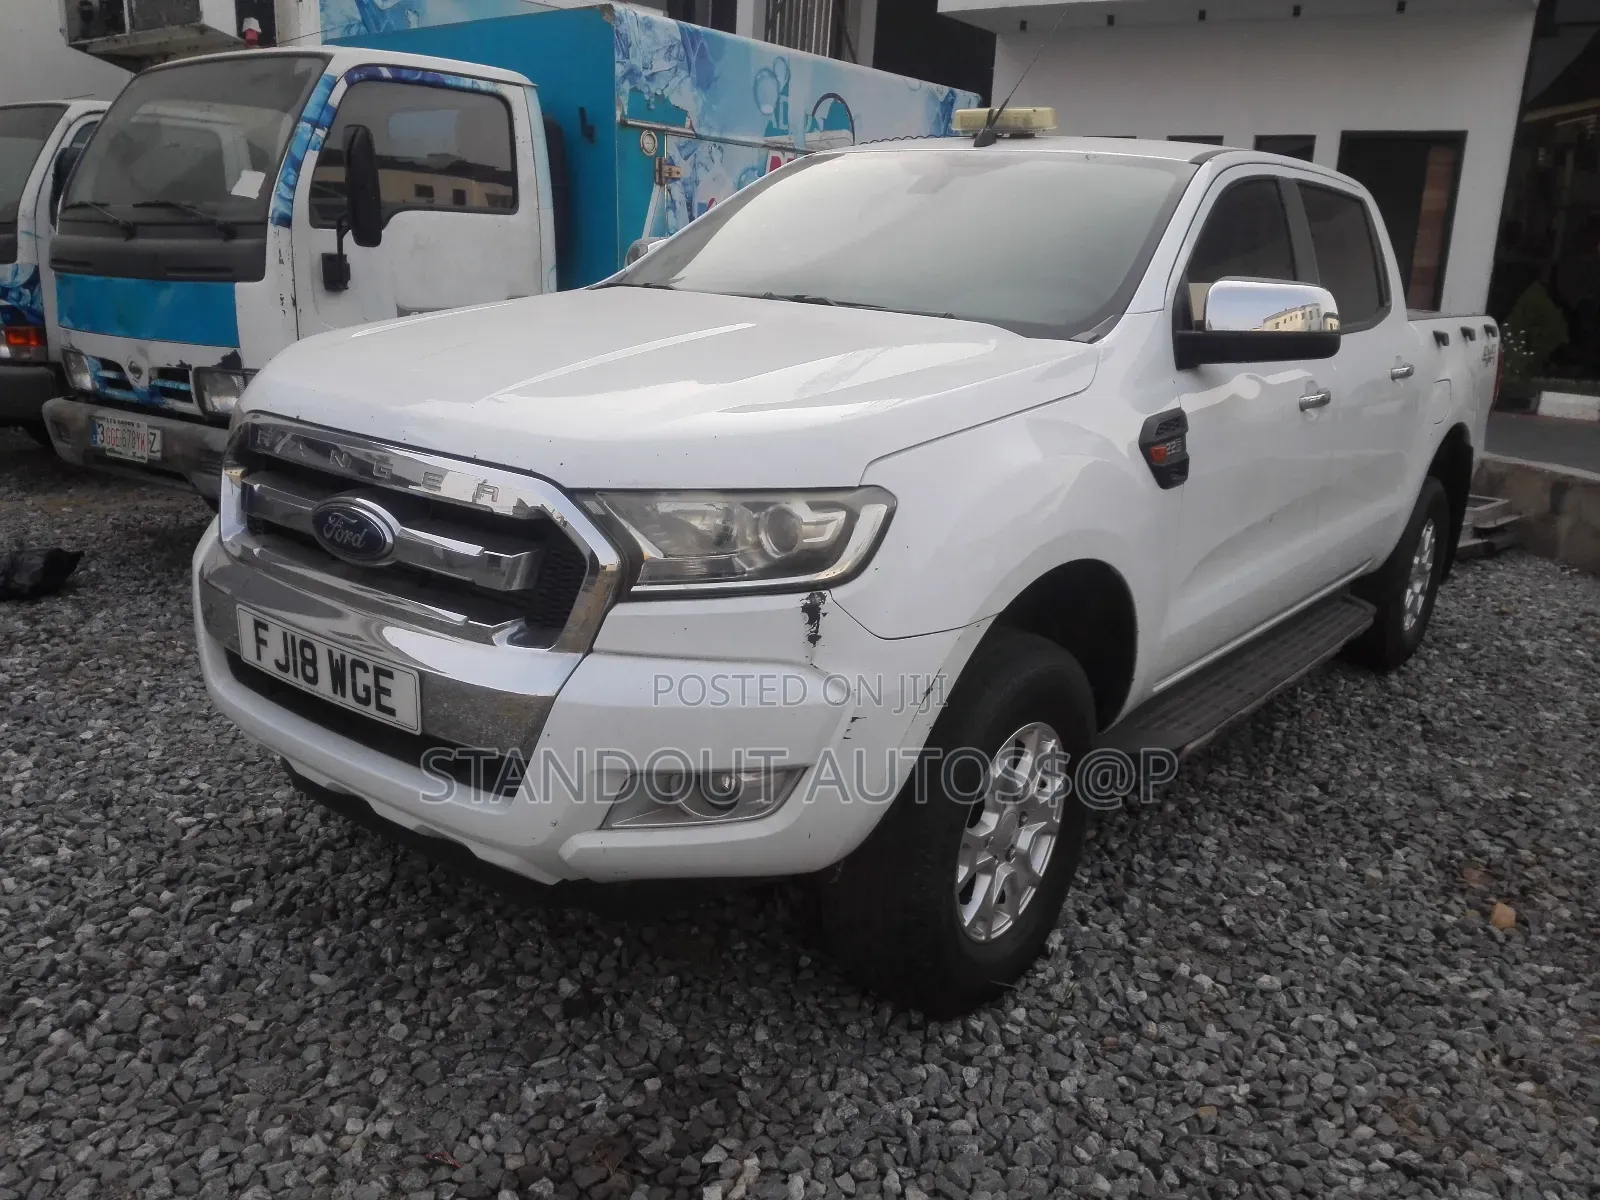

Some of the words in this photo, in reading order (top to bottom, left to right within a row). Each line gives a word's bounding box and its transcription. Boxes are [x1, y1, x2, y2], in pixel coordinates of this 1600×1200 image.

[323, 512, 366, 549] Ford
[253, 618, 319, 686] FJ18
[327, 648, 397, 717] WGE
